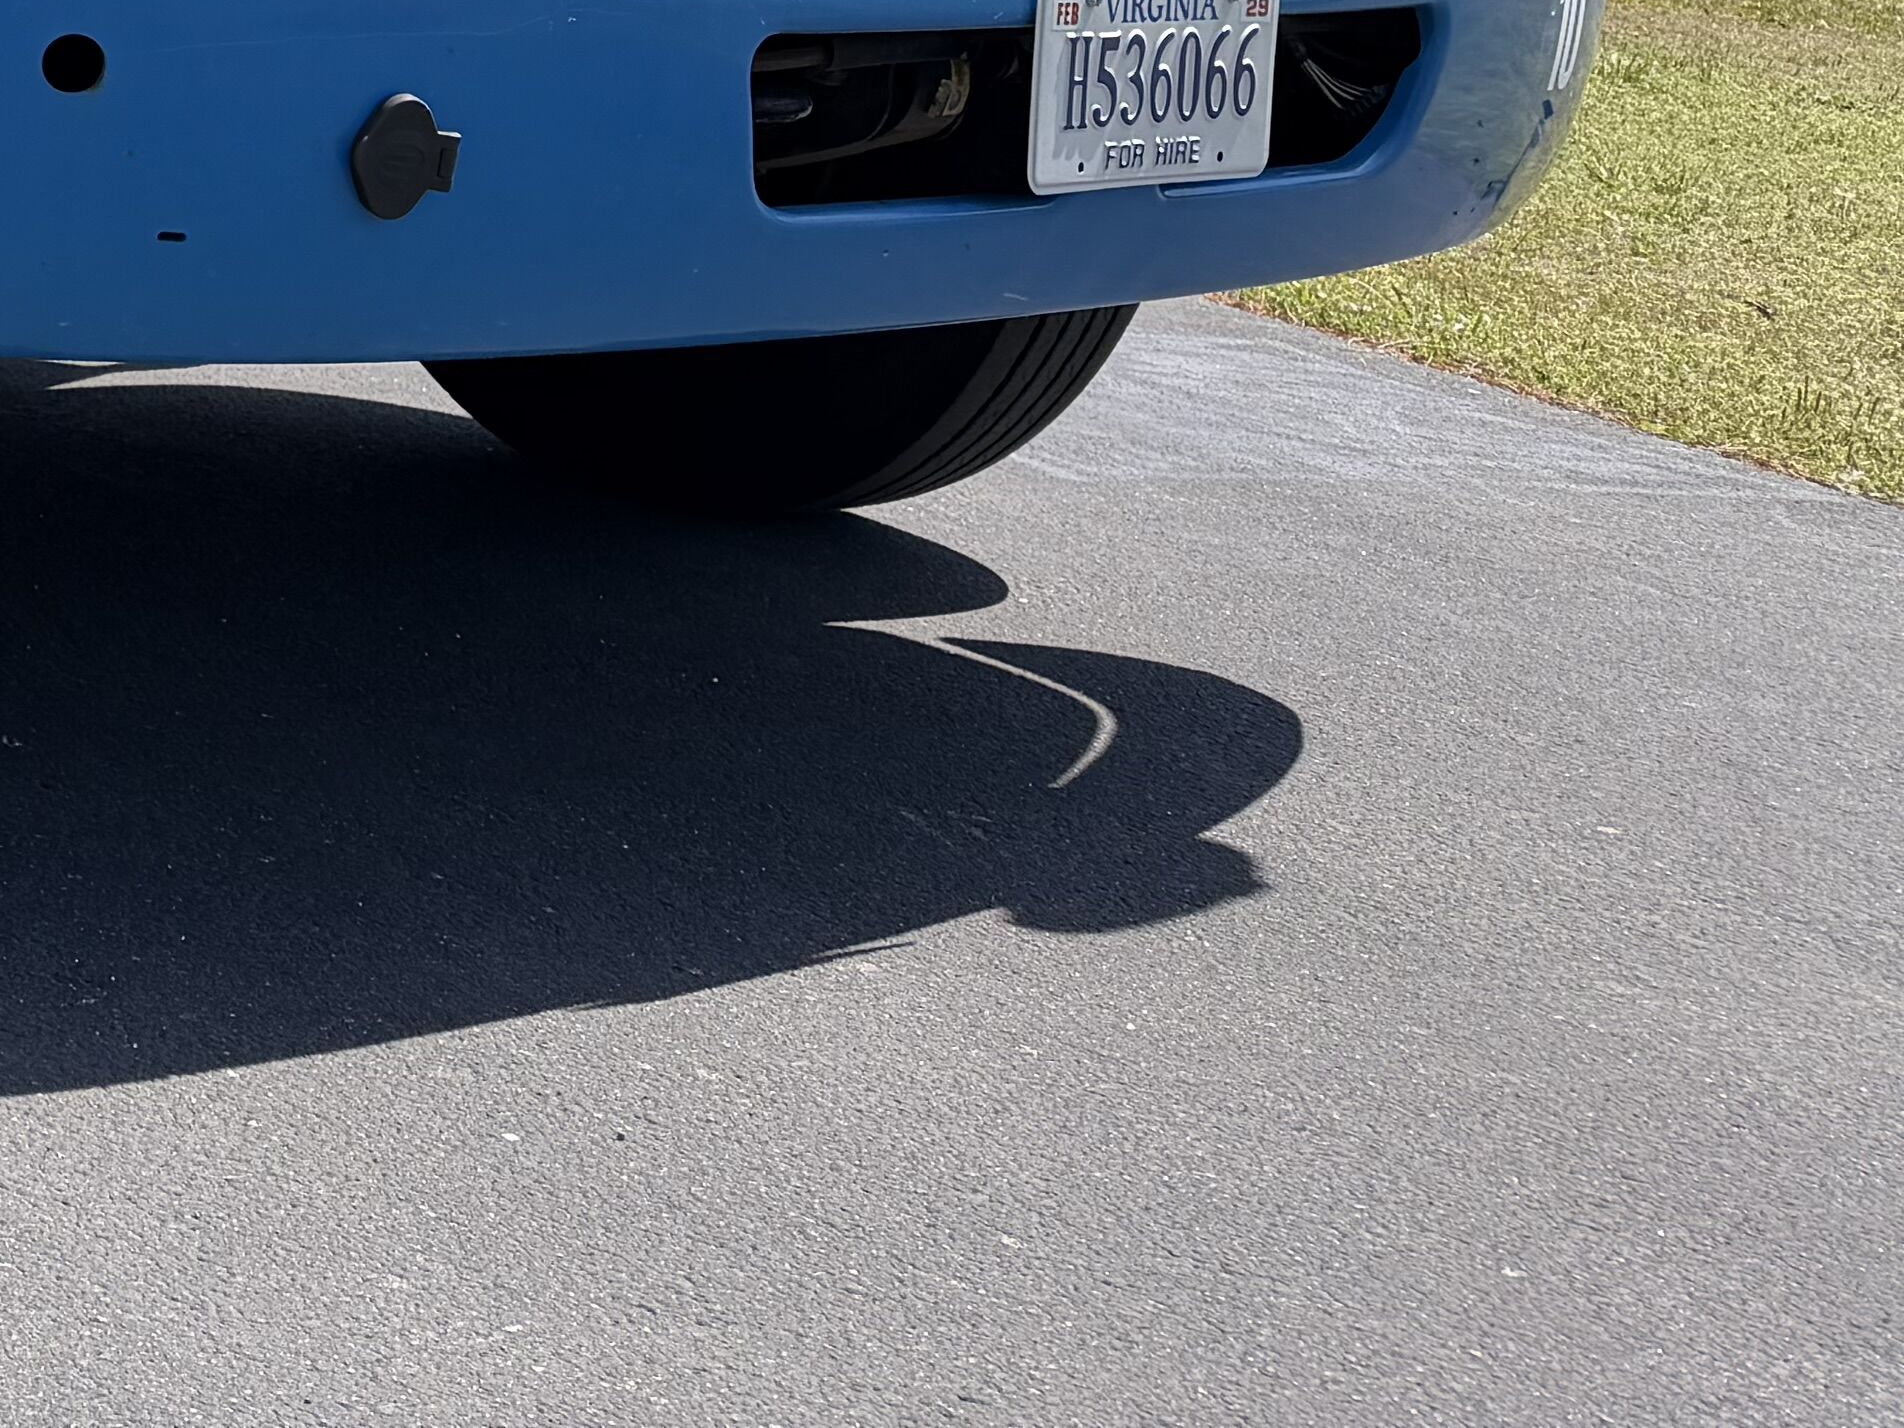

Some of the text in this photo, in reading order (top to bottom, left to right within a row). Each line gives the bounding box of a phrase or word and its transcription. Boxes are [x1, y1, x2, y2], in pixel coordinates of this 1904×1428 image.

[1056, 2, 1080, 26] FEB
[1063, 23, 1260, 131] H536066
[1104, 136, 1201, 170] FOR HIRE
